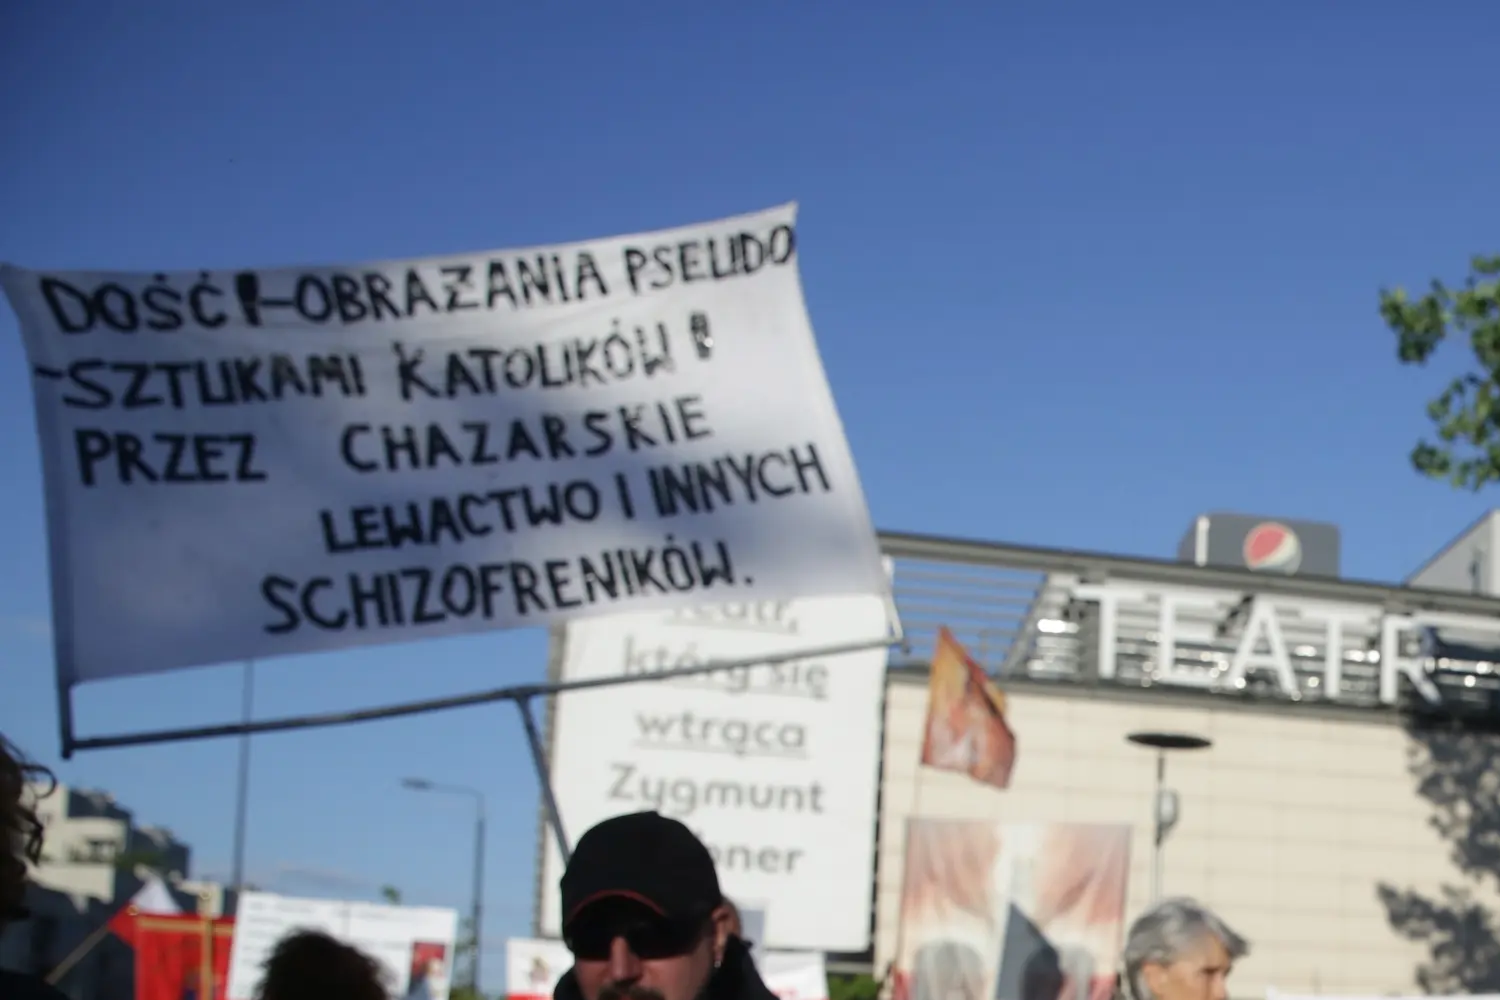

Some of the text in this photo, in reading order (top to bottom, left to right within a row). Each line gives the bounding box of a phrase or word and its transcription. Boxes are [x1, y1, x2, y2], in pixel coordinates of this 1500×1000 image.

[392, 319, 674, 401] KATOLIKÓW
[75, 396, 713, 486] PRZEZ CHAZARSKIE
[319, 443, 831, 554] LEWACTWO I INNYCH
[261, 534, 754, 635] SCHIZOFRENIKÓW.
[1073, 583, 1441, 704] TEATR
[634, 711, 808, 760] wtrąca
[607, 762, 825, 818] Zygmunt
